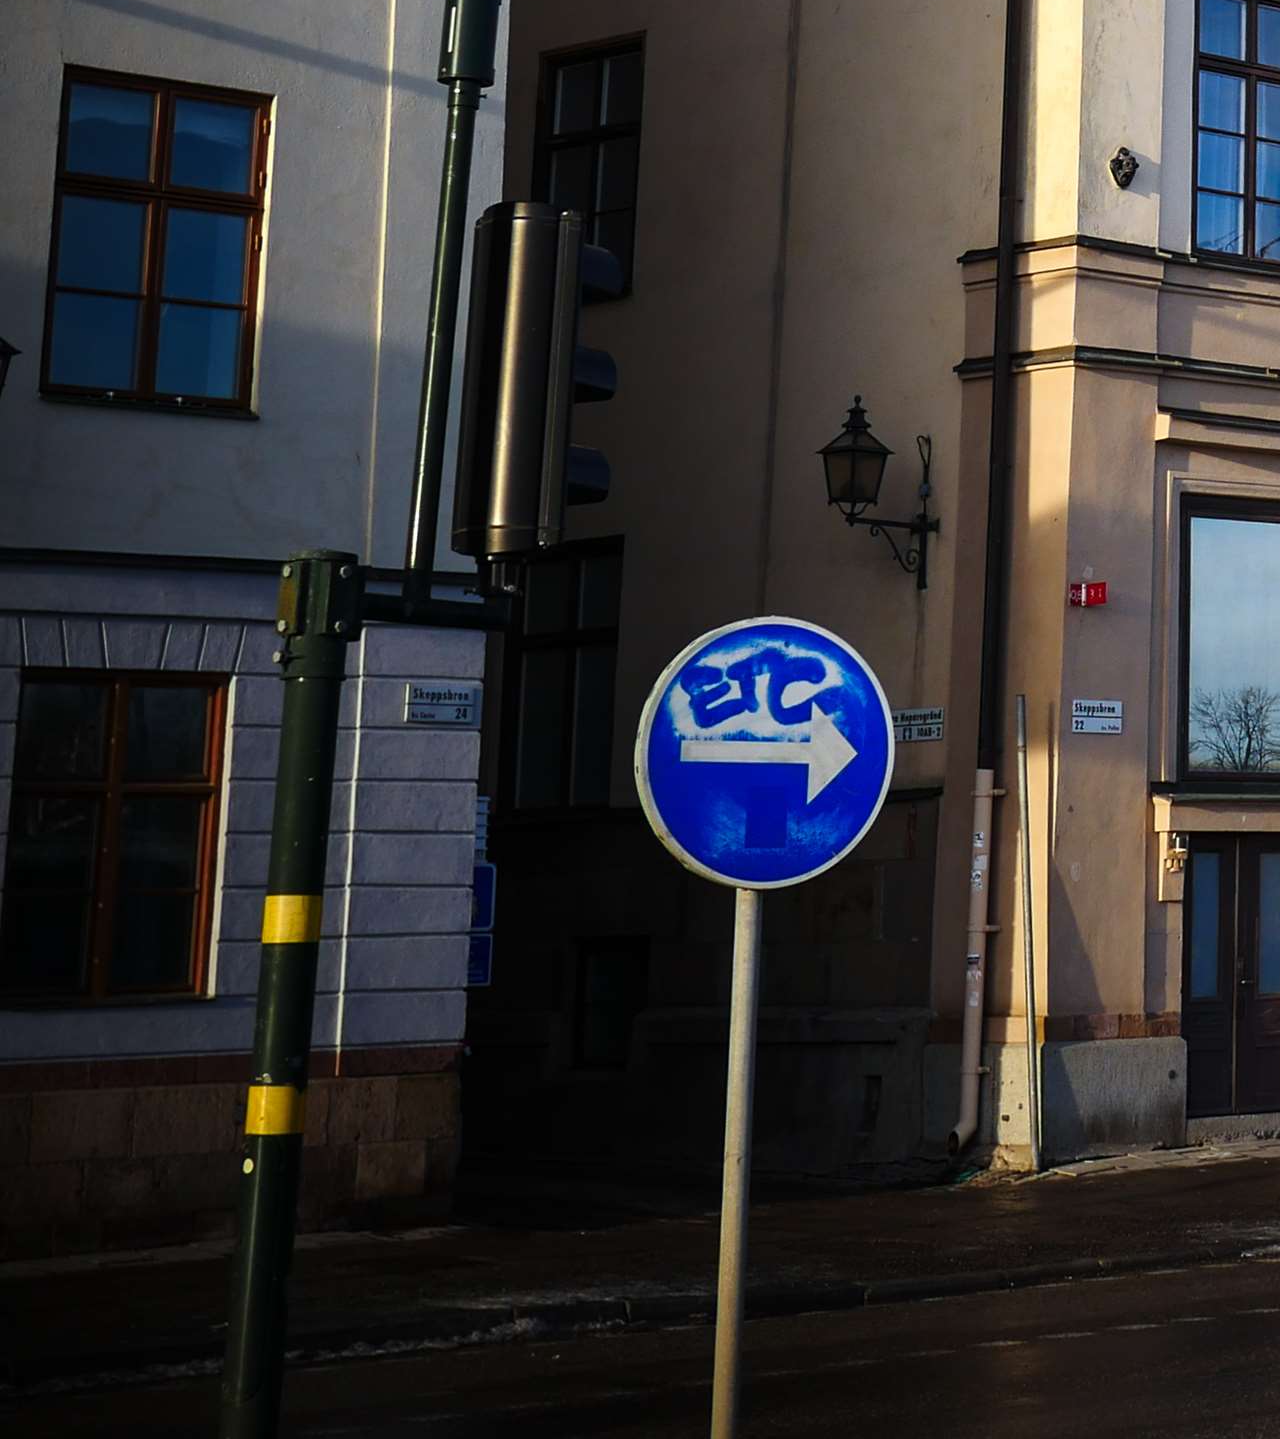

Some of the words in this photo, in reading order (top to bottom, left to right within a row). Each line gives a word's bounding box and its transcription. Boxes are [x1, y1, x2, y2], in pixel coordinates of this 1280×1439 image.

[413, 687, 469, 703] Skeppsbron
[455, 707, 468, 720] 24
[1074, 701, 1116, 717] Skeppsbron
[1074, 719, 1085, 730] 22
